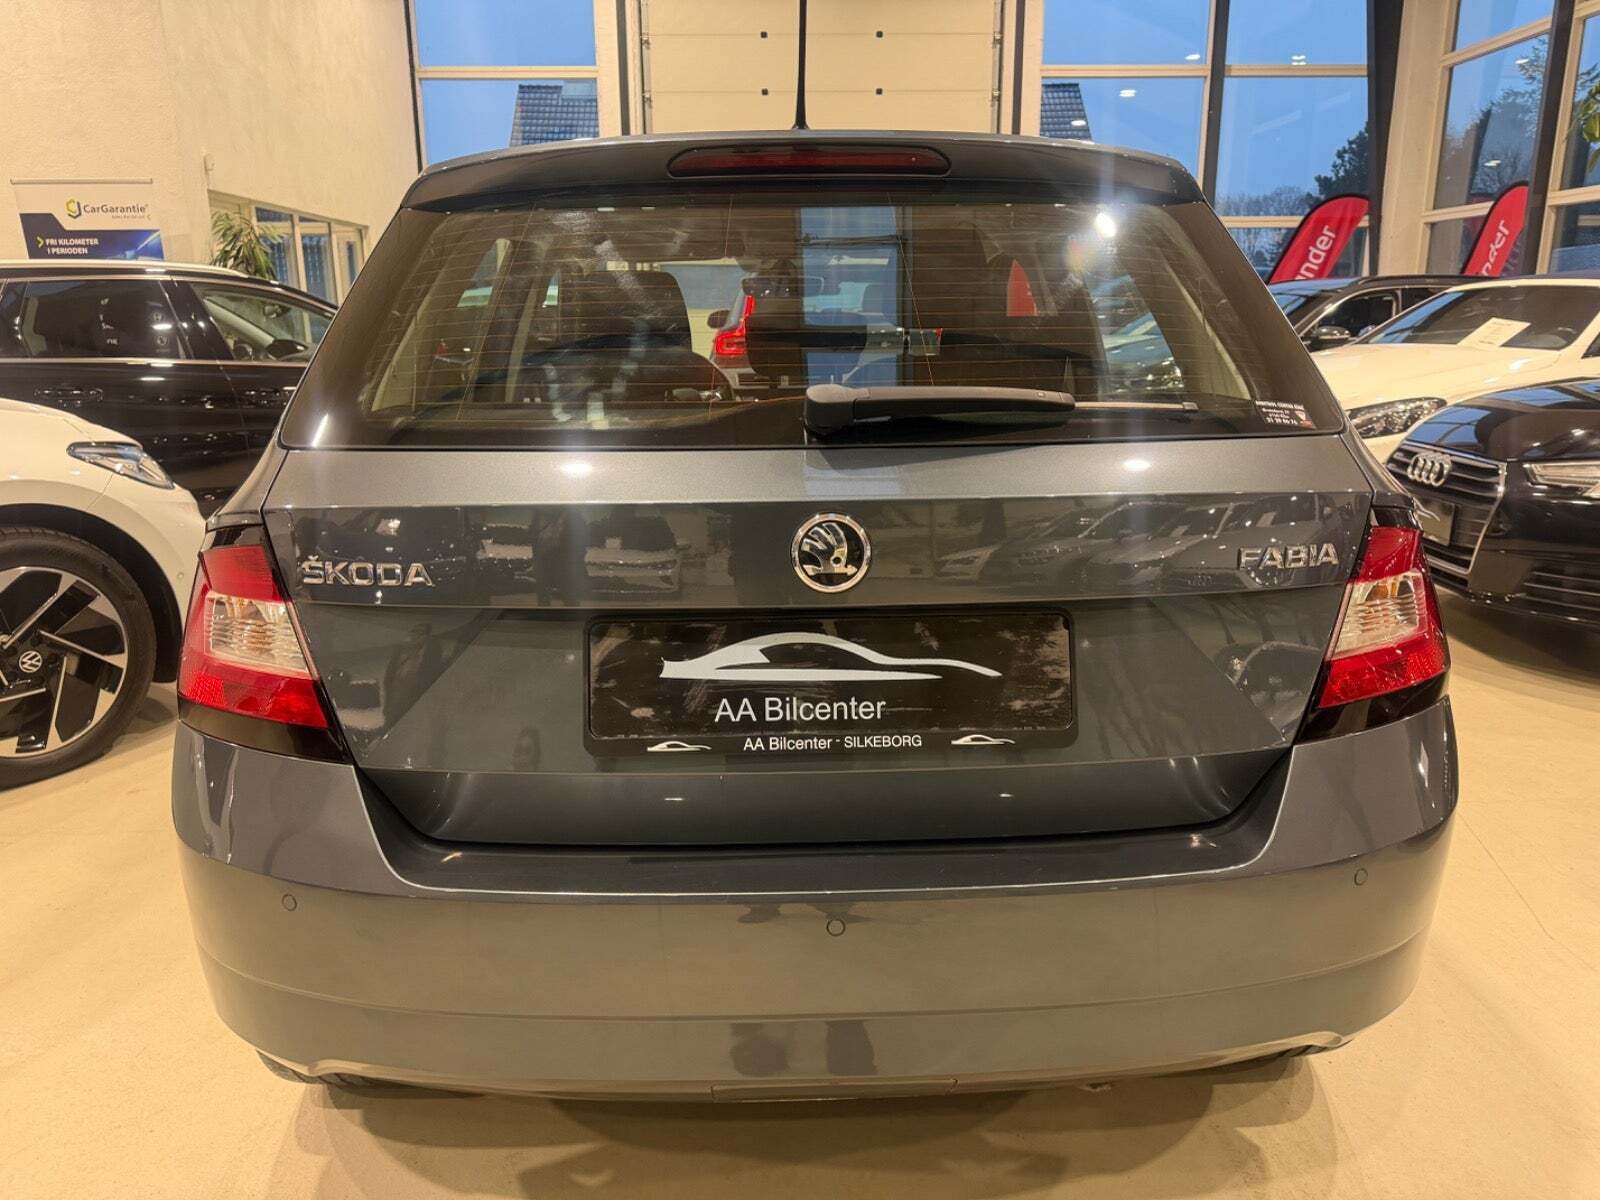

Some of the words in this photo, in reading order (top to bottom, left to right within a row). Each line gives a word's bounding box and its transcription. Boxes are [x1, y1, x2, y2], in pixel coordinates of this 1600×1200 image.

[83, 204, 146, 214] CarGarantie
[51, 247, 88, 255] PERIODEN
[58, 238, 99, 246] KILOMETER
[1295, 224, 1337, 280] nder
[1237, 543, 1340, 570] FABIA
[301, 554, 435, 588] ŠKODA
[714, 697, 757, 723] AA
[764, 696, 887, 722] Bilcenter
[743, 737, 765, 751] AA
[768, 736, 833, 751] Bilcenter
[844, 734, 922, 749] SILKEBORG
